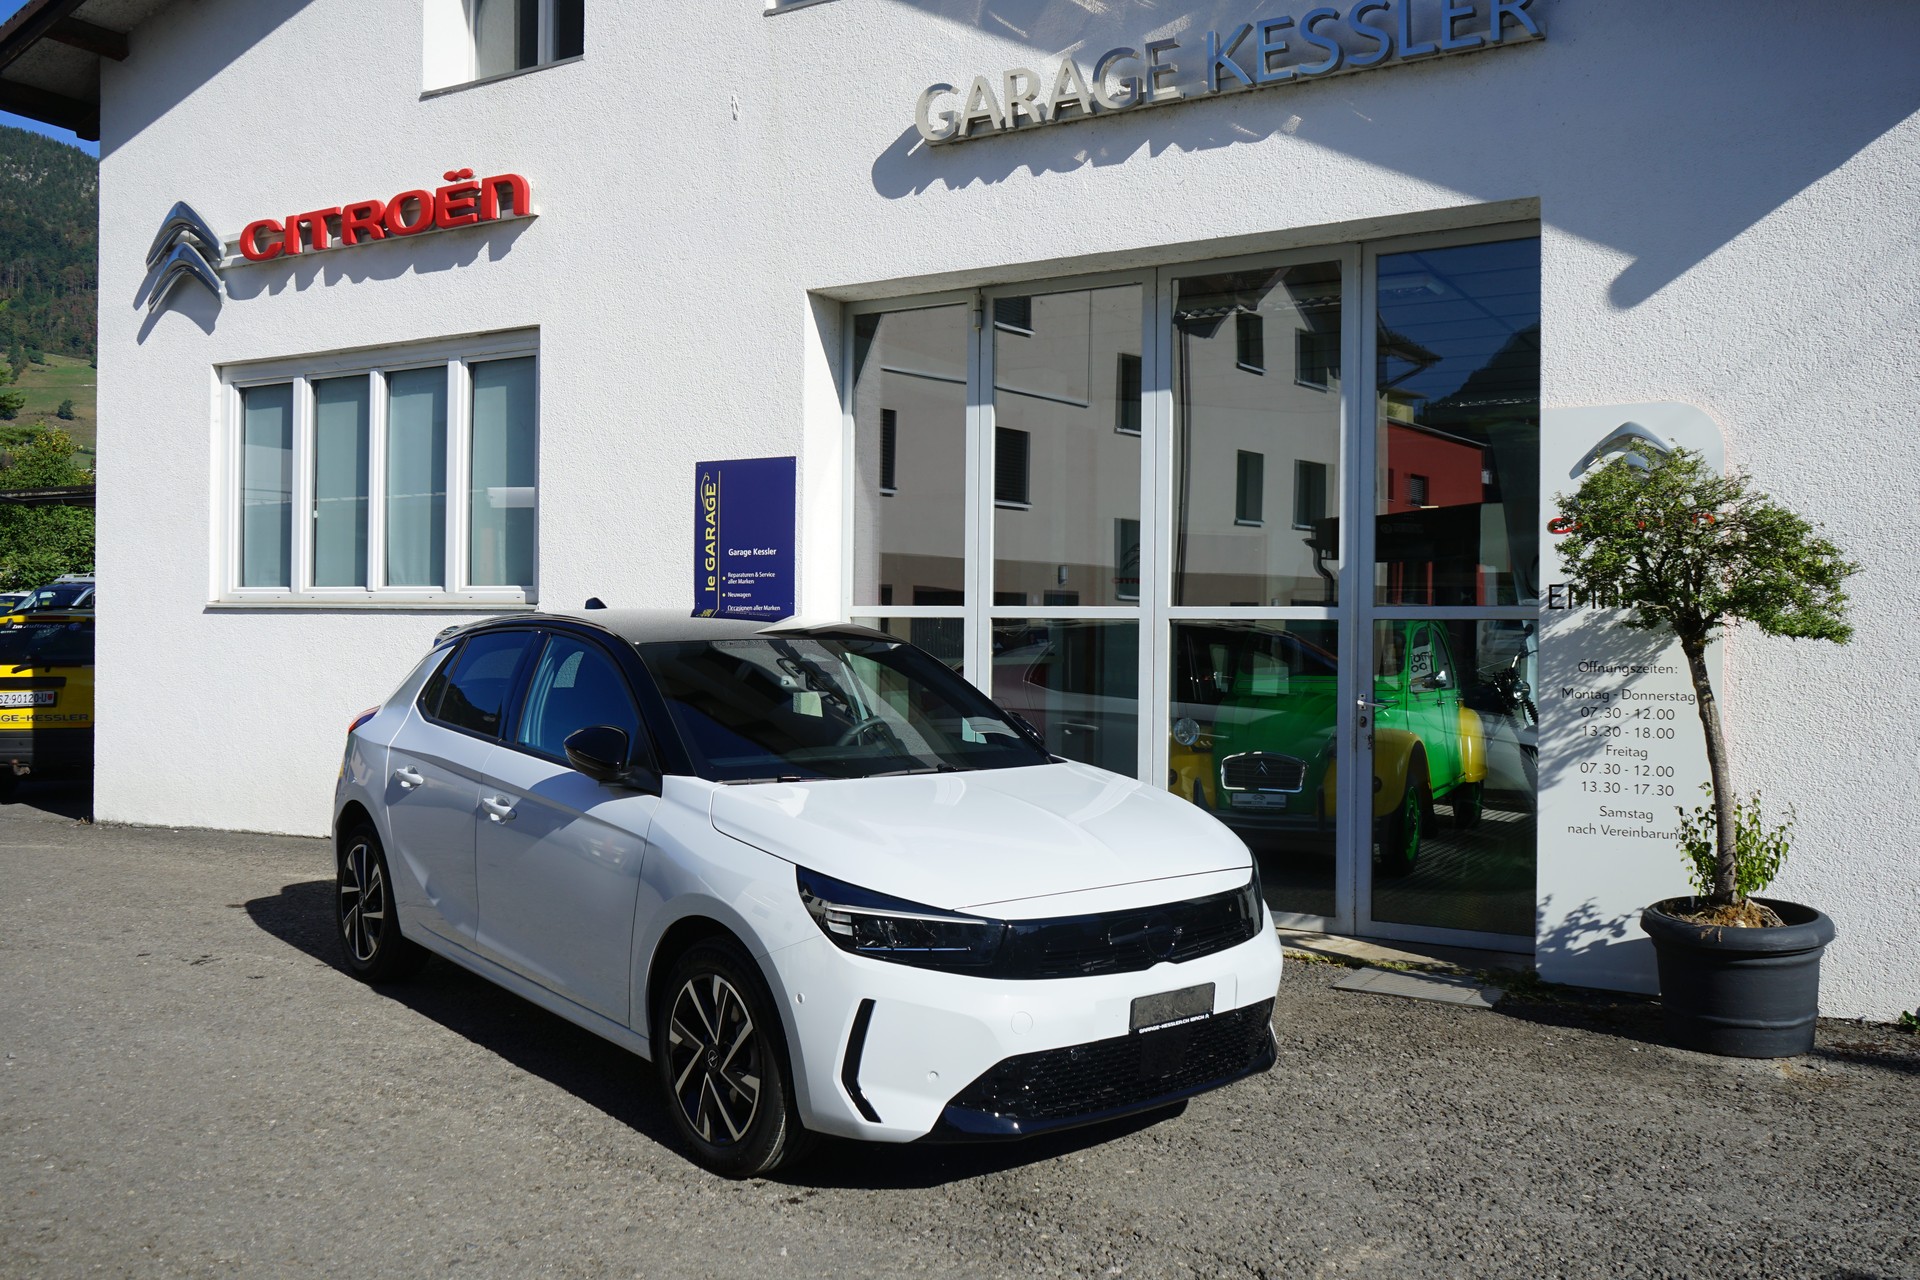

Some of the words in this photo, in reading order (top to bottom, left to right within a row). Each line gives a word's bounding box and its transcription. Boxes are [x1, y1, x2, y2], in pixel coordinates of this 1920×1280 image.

[915, 36, 1183, 142] GARAGE
[1206, 0, 1541, 93] KESSLER
[239, 168, 531, 261] CITROËN
[705, 483, 717, 571] GARAGE
[728, 548, 752, 558] Garage
[753, 547, 777, 556] Kessler
[705, 576, 716, 591] le
[1578, 659, 1678, 677] Öffnungszeiten:
[1561, 688, 1610, 703] Montag
[1621, 689, 1696, 706] Donnerstag
[1581, 706, 1621, 719] 07.30
[1635, 708, 1675, 720] 12.00
[1582, 725, 1621, 738] 13.30
[1635, 727, 1675, 740] 18.00
[1606, 745, 1648, 761] Freitag
[1580, 762, 1621, 775] 07.30
[1634, 764, 1675, 777] 12.00
[1581, 781, 1621, 794] 13.30
[1634, 783, 1675, 797] 17.30
[1599, 805, 1654, 823] Samstag
[1567, 823, 1597, 835] nach
